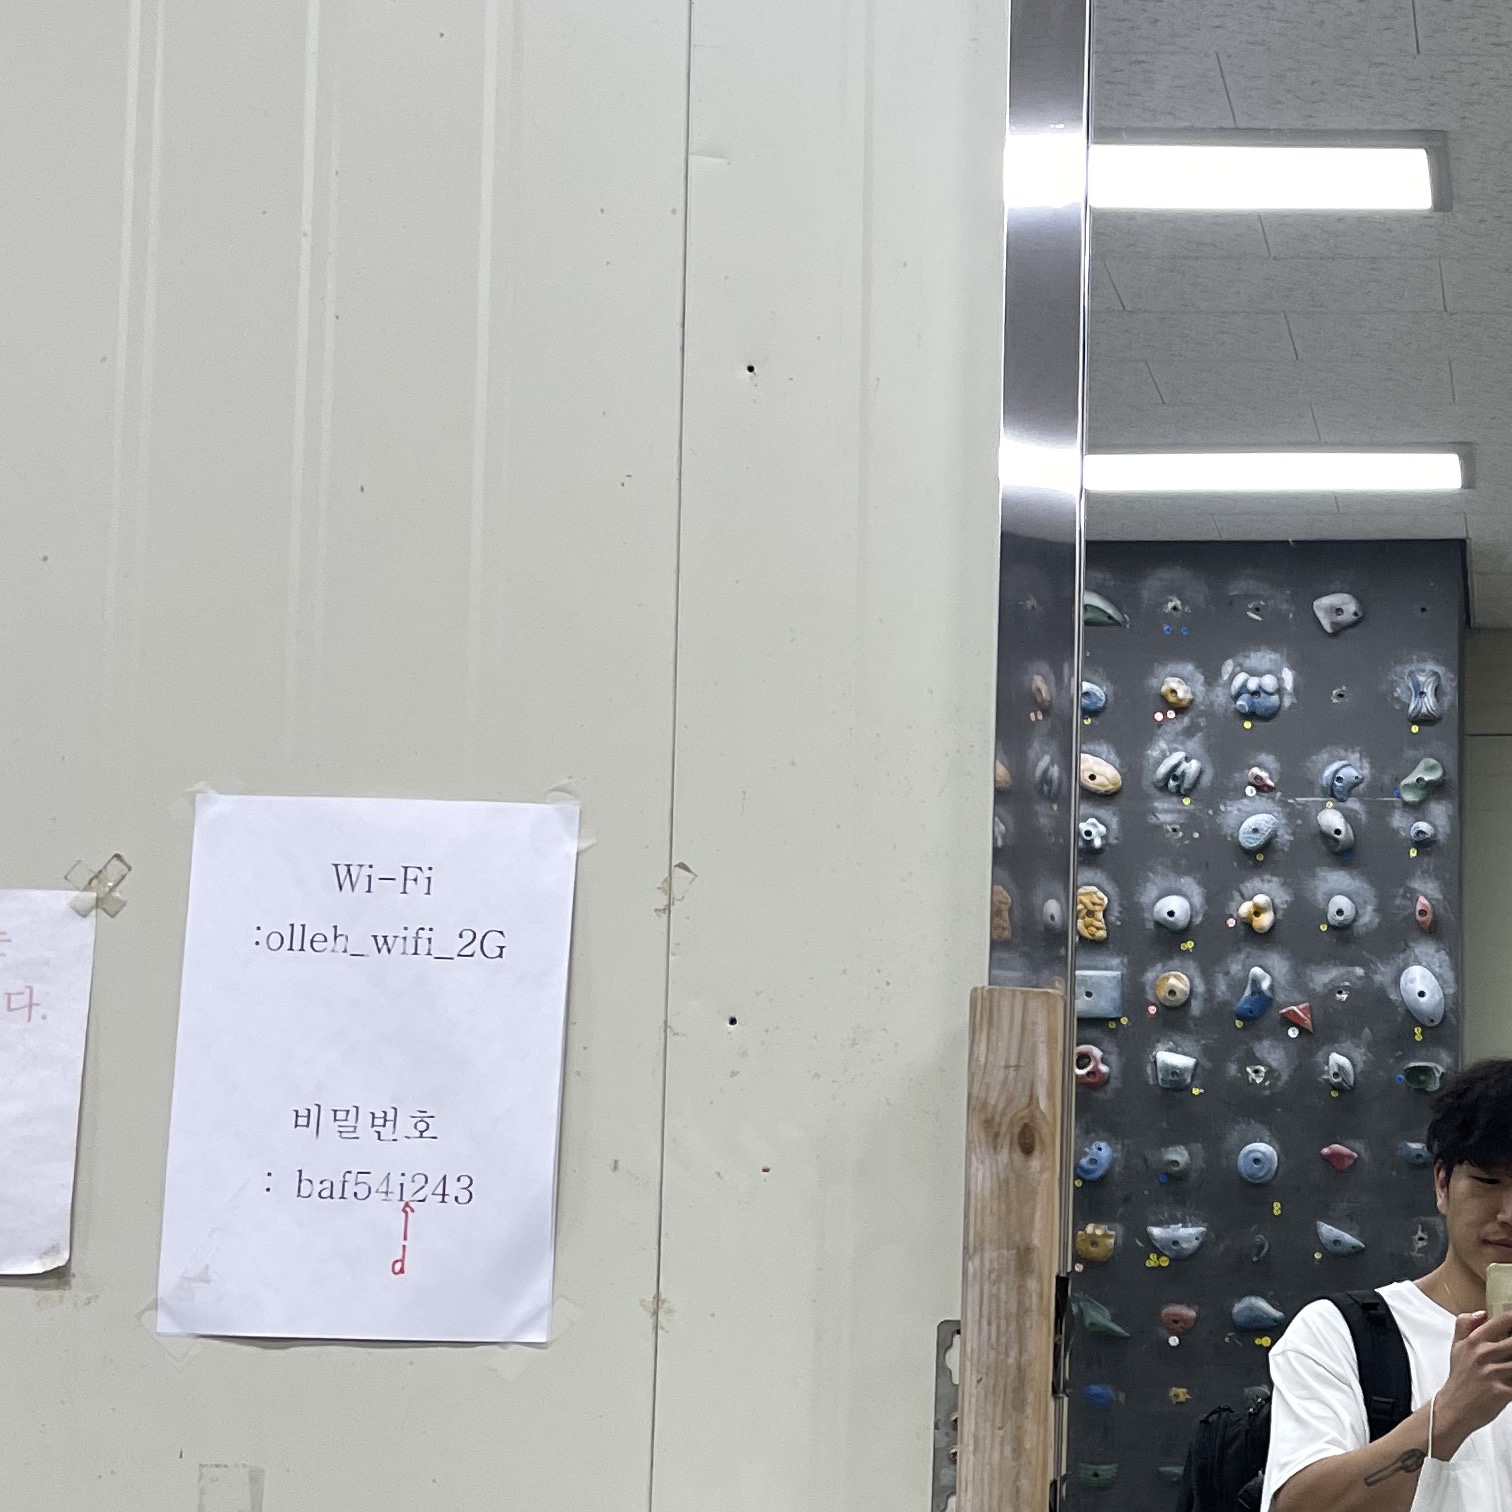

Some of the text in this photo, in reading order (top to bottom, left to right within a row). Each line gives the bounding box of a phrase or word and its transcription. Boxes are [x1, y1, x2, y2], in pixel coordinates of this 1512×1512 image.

[331, 863, 433, 896] Wi-Fi
[292, 1103, 438, 1142] 비밀번호
[296, 1168, 475, 1205] baf54i243
[391, 1244, 407, 1276] d
